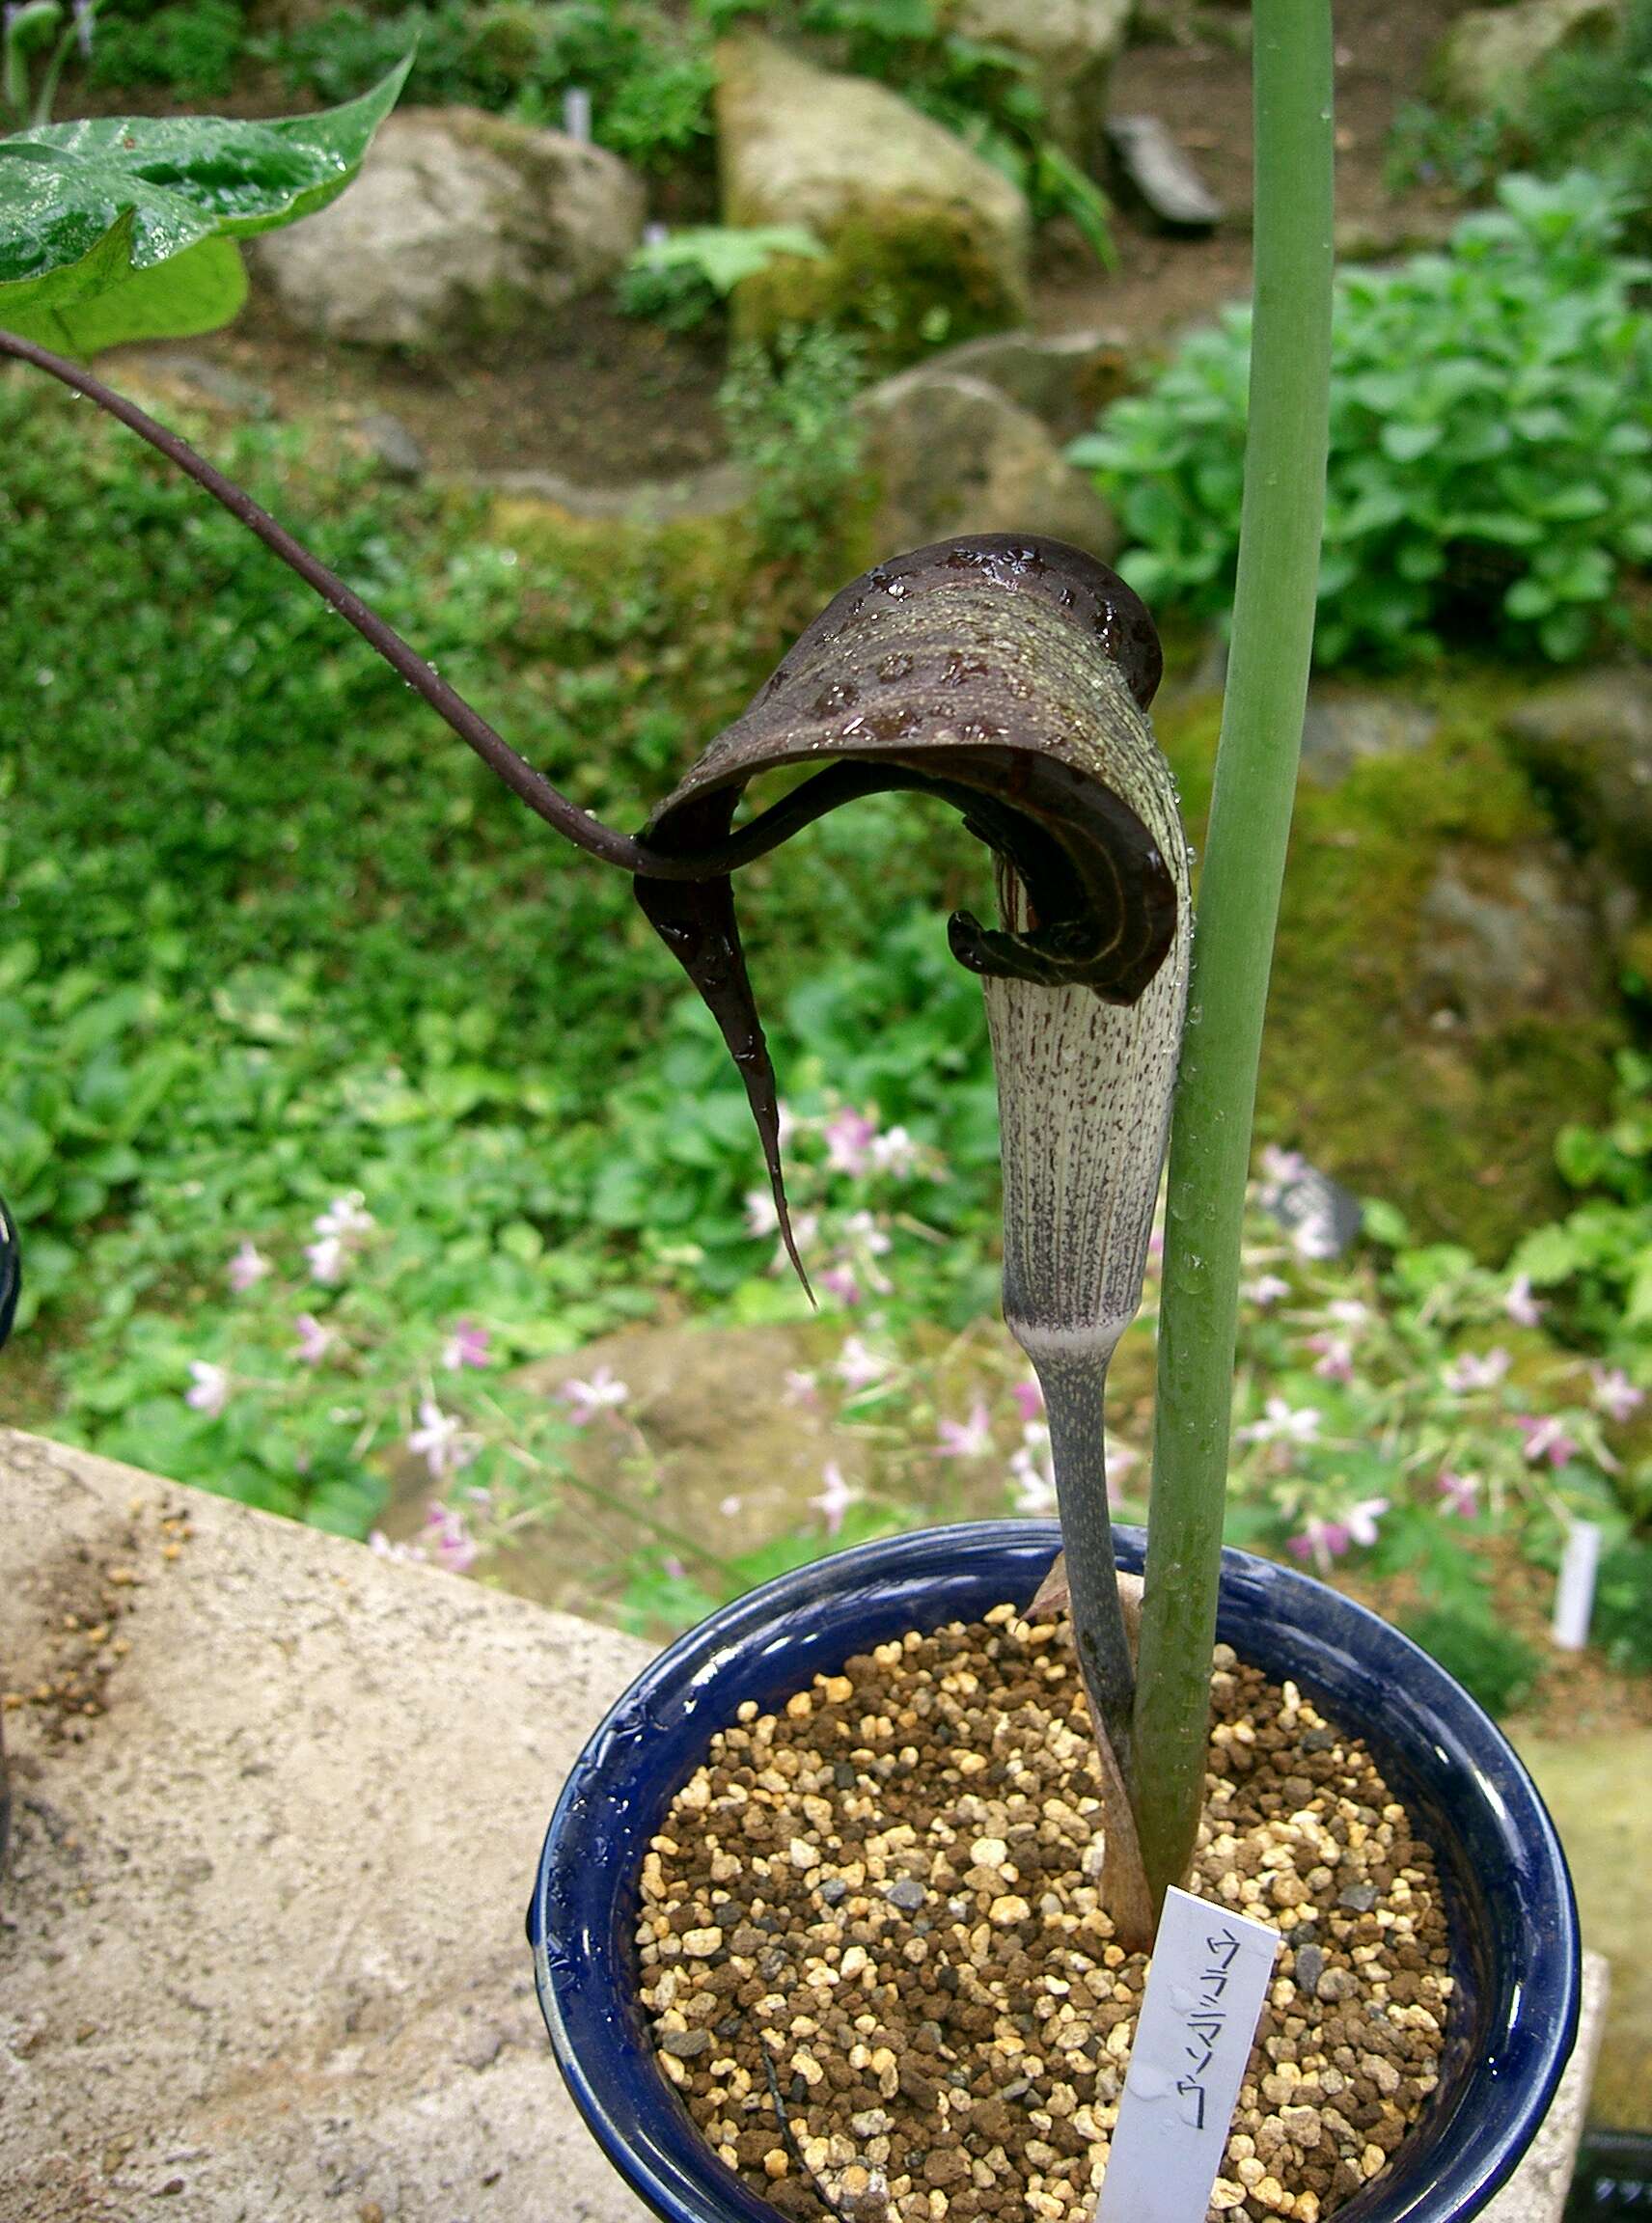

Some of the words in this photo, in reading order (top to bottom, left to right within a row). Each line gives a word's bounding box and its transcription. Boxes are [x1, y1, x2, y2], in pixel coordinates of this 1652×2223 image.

[1176, 1928, 1242, 2129] ウラシマソウ
